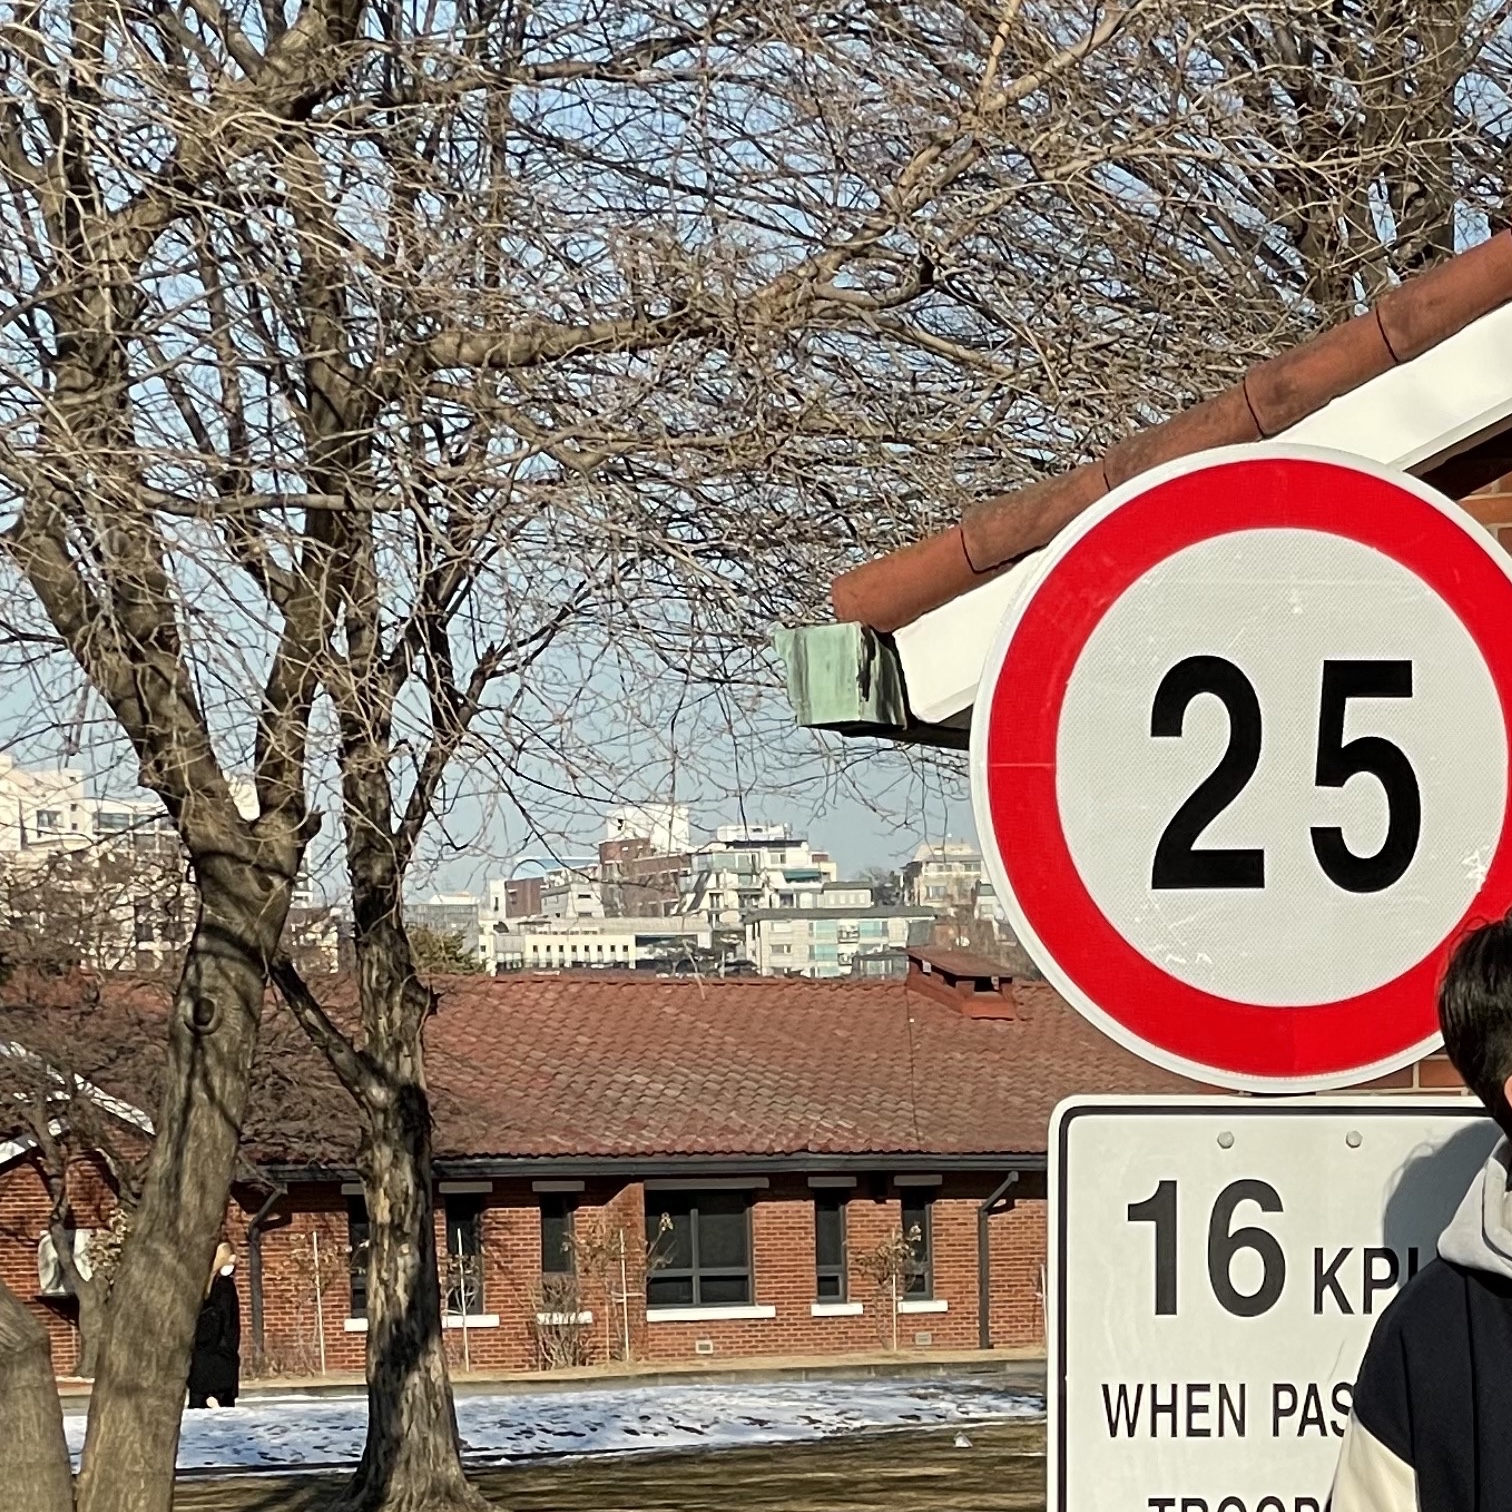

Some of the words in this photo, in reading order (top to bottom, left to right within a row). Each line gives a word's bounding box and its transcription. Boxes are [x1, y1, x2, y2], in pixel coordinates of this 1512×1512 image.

[1150, 655, 1421, 893] 25
[1127, 1179, 1286, 1317] 16
[1101, 1383, 1246, 1437] WHEN
